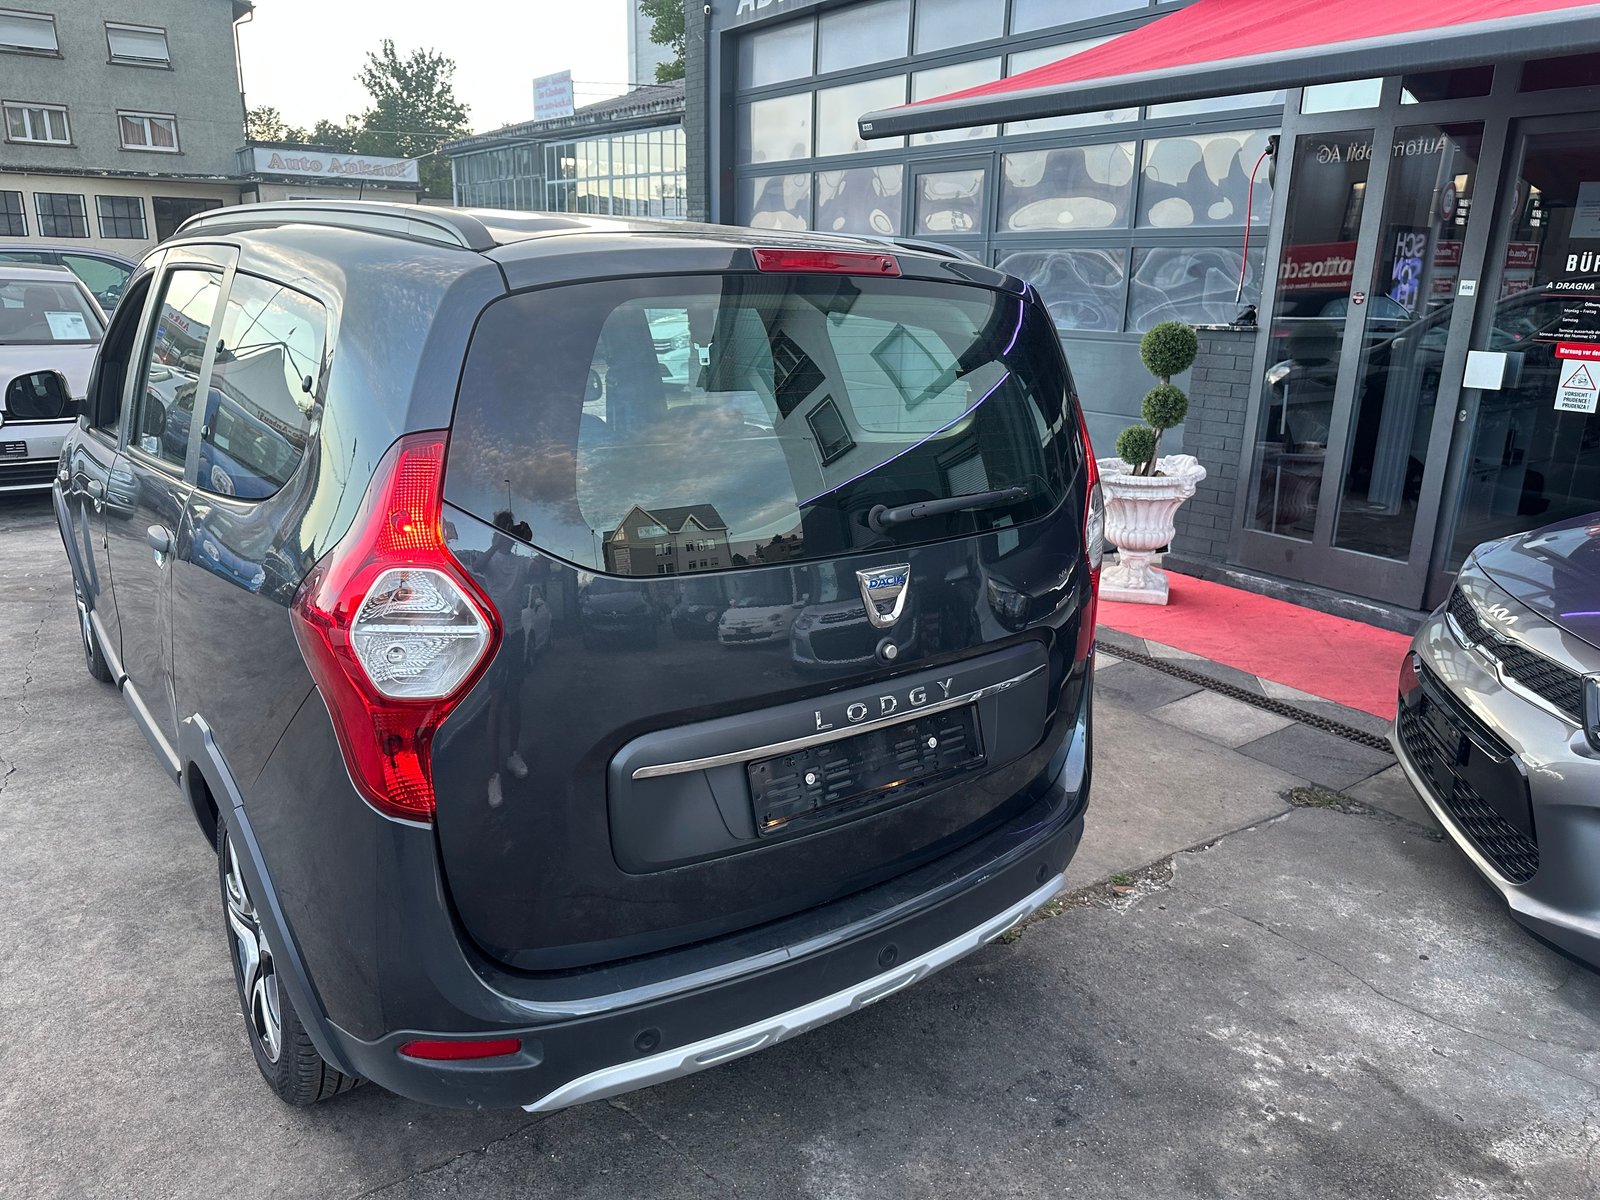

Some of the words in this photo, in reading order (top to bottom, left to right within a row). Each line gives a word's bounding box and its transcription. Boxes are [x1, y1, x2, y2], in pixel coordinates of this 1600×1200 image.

[268, 152, 323, 172] Auto
[328, 157, 406, 178] Ankauf
[1546, 281, 1553, 289] A
[1555, 282, 1595, 291] DRAGNA
[1559, 347, 1582, 356] Warnung
[868, 574, 906, 590] DACIA
[814, 677, 953, 731] LODGY
